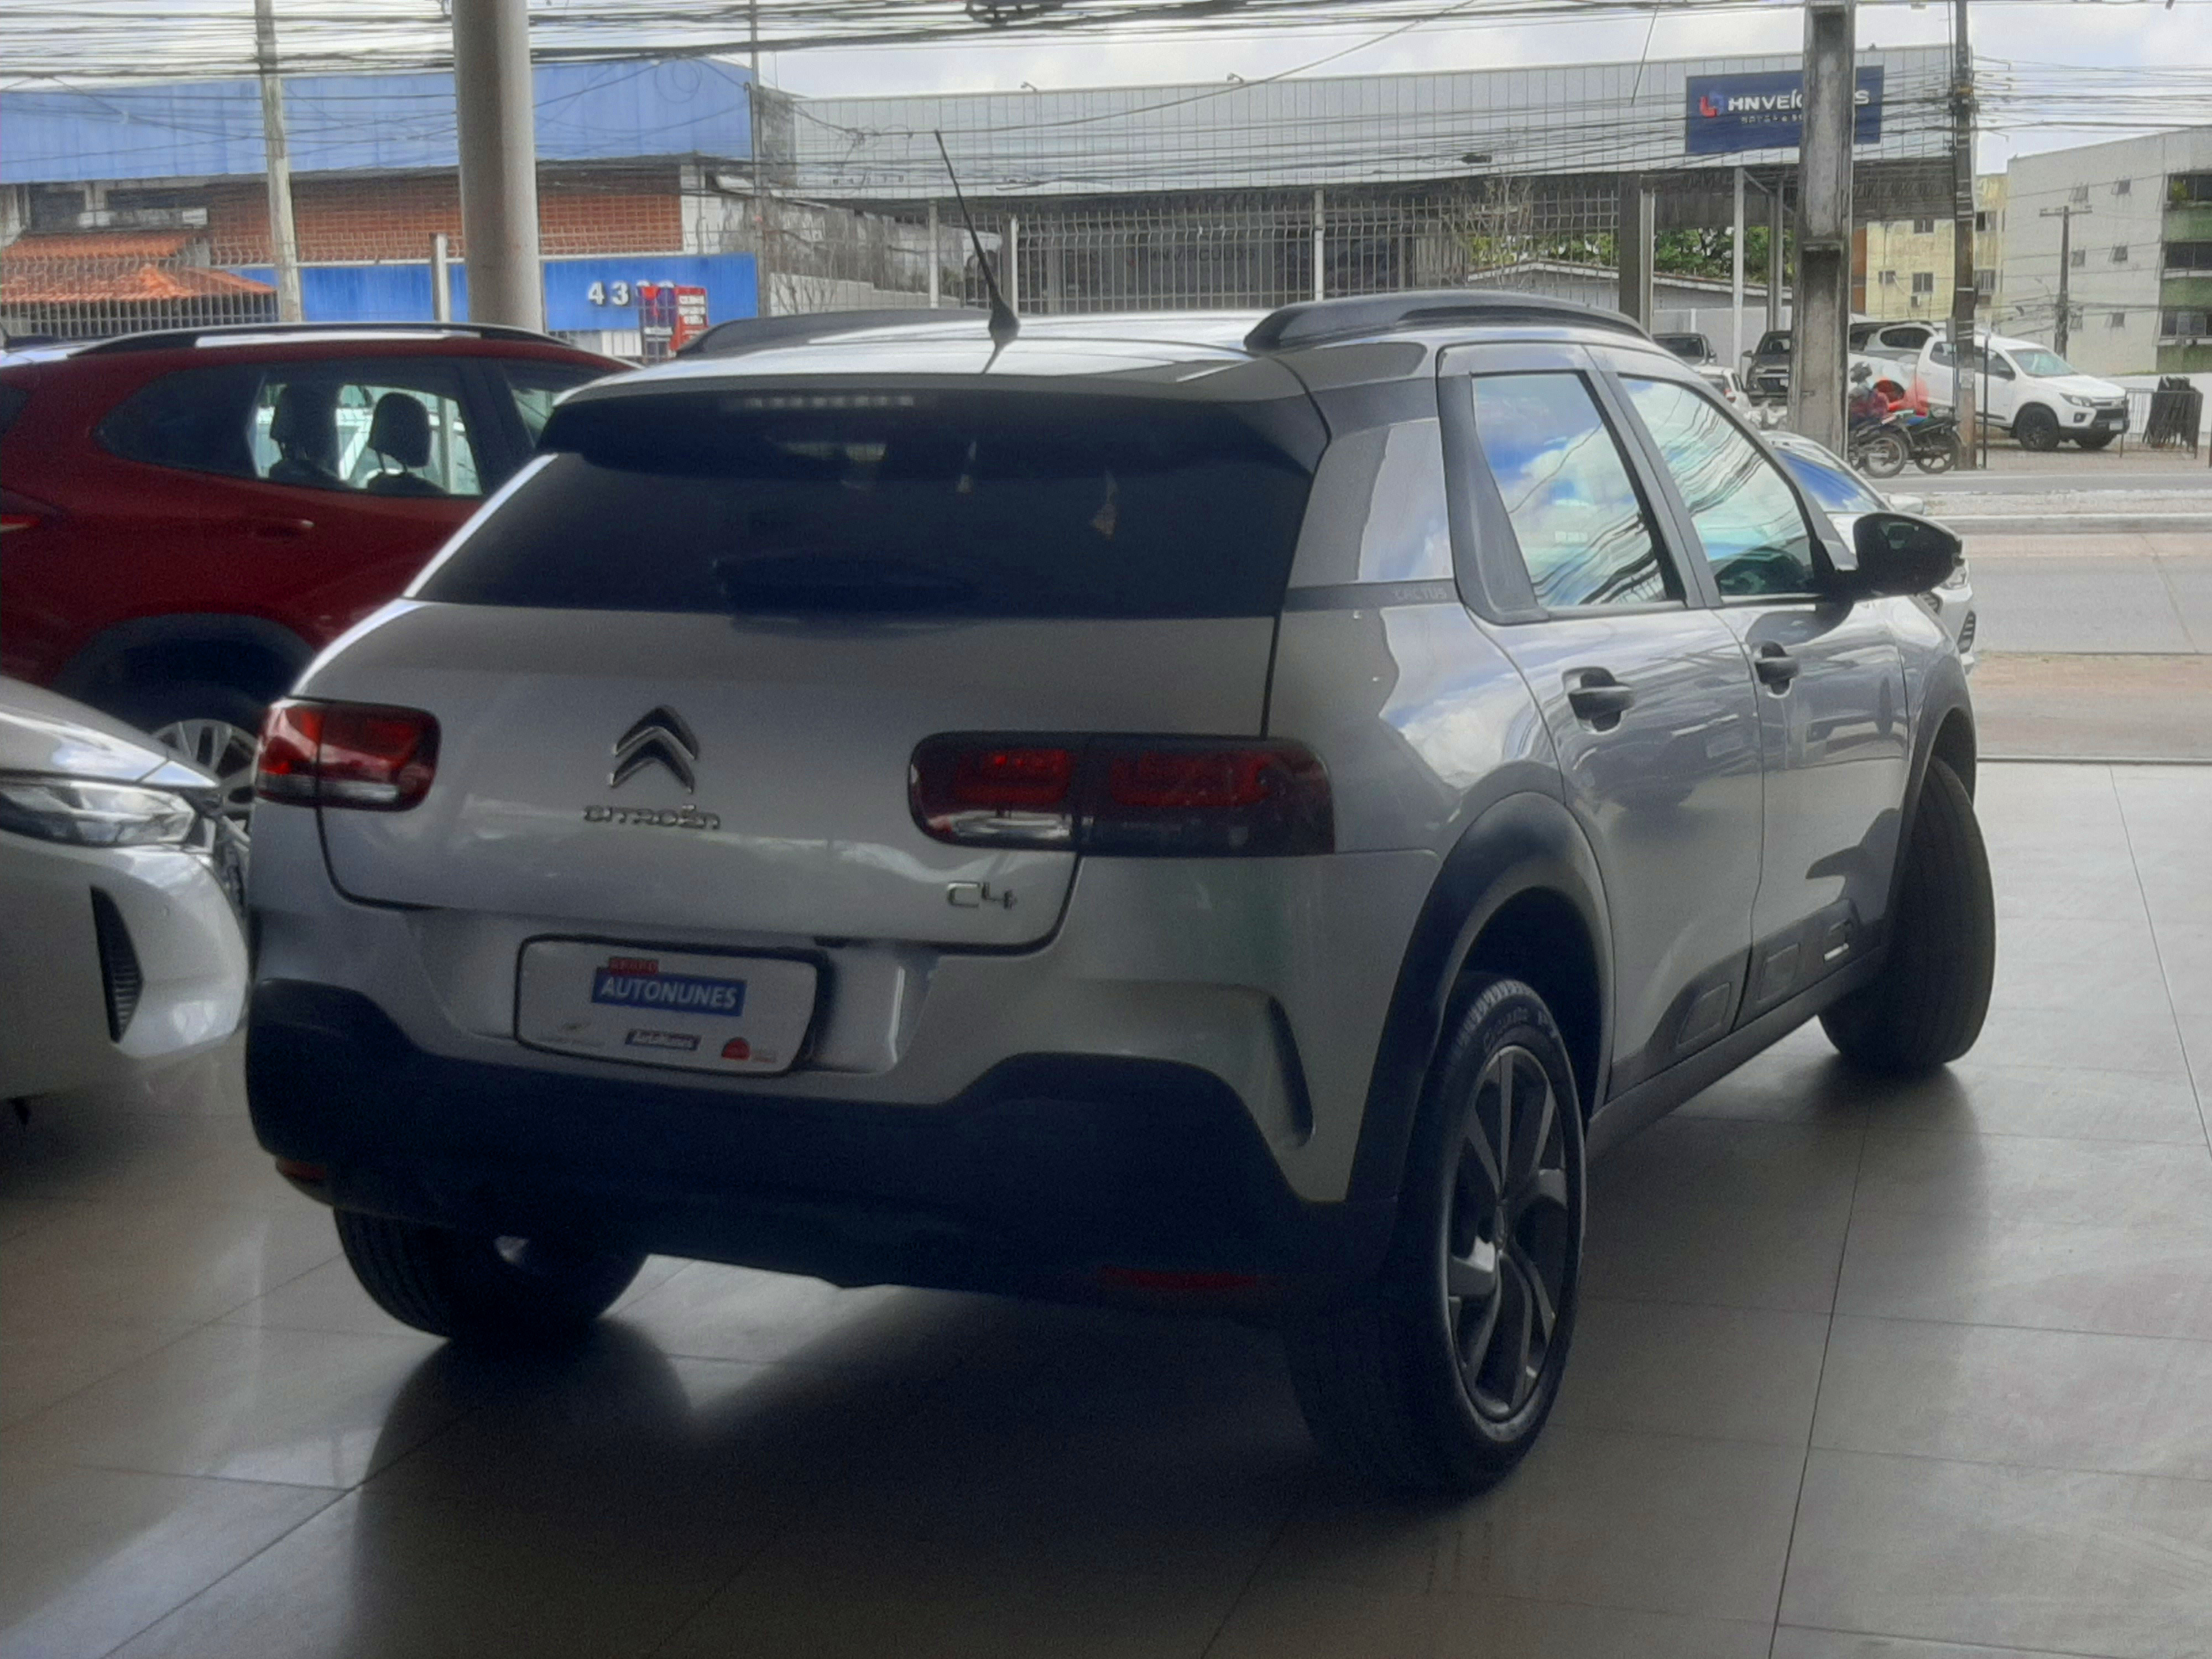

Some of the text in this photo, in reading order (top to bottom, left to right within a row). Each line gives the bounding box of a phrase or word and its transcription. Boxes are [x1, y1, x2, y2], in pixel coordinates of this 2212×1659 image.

[587, 280, 676, 306] 43
[947, 880, 1016, 910] C4
[601, 977, 738, 1009] AUTONUNES
